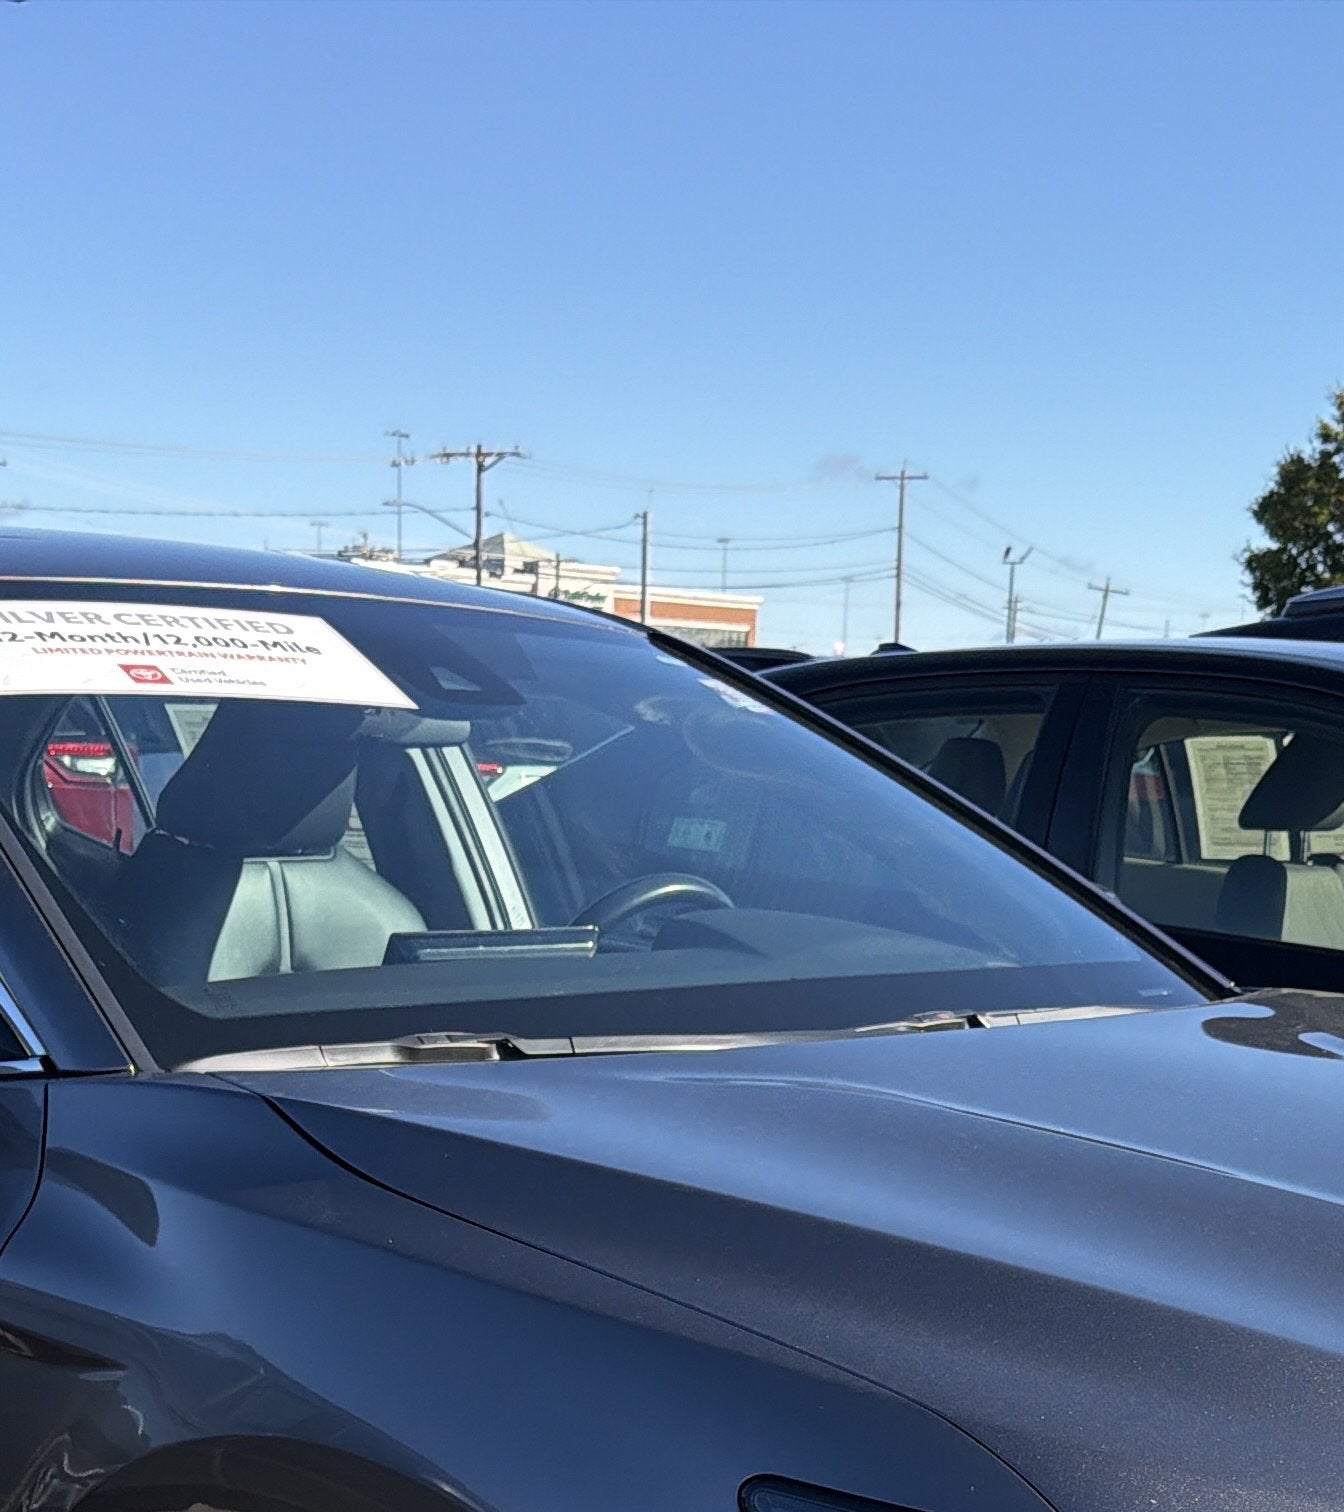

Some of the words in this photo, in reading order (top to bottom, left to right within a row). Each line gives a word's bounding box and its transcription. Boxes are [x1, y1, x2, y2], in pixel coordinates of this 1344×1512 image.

[113, 612, 294, 635] CERTIFIED
[31, 647, 103, 656] LIMITED
[105, 648, 216, 660] POWERTRAIN
[217, 653, 308, 665] WARRANTY
